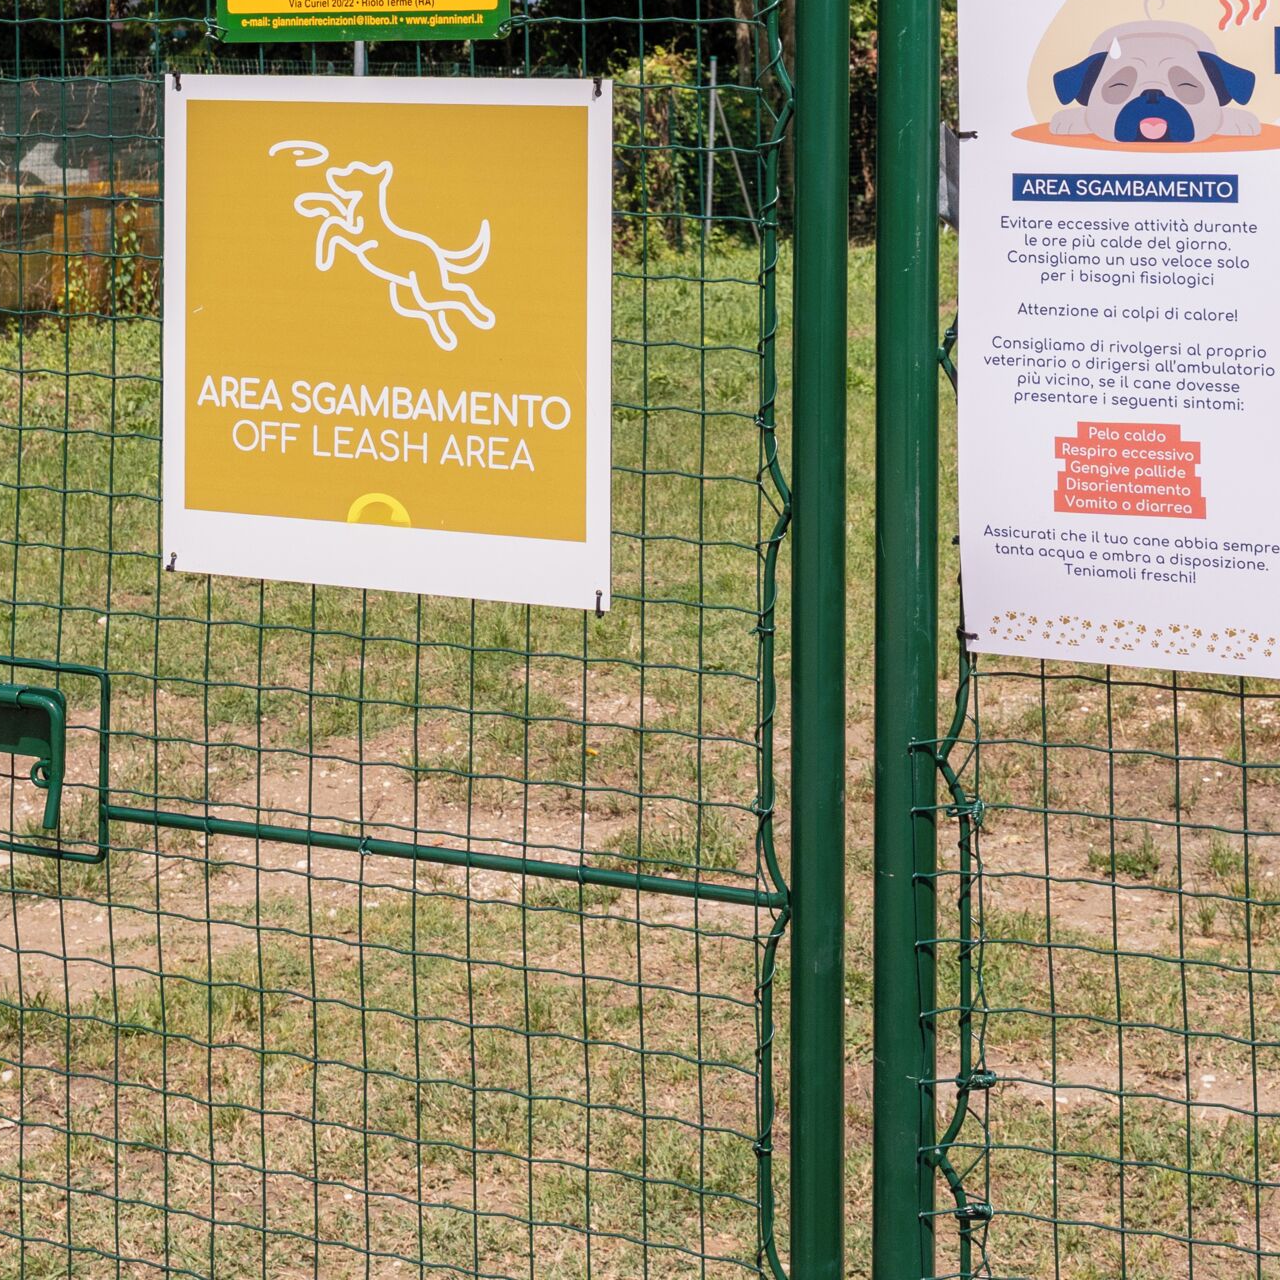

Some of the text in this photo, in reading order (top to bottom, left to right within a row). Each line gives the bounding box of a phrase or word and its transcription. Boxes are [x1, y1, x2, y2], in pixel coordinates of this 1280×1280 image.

[288, 0, 302, 8] Via
[241, 13, 484, 30] e-mail: gianninerirecinzioni@libero.it www.giannineri.it
[1022, 179, 1233, 198] AREA SGAMBAMENTO
[1001, 215, 1258, 234] Evitare eccessive attività durante
[1024, 233, 1231, 253] le ore più calde del giorno.
[1007, 250, 1250, 269] Consigliamo un uso veloce solo
[1040, 272, 1066, 284] per
[1080, 270, 1135, 287] bisogni
[1140, 270, 1214, 289] fisiologici
[1017, 302, 1238, 322] Attenzione ai colpi di calore!
[992, 335, 1267, 361] Consigliamo di rivolgersi al proprio
[984, 354, 1067, 368] veterinario
[1085, 357, 1150, 374] dirigersi
[1017, 371, 1240, 393] più vicino, se il cane dovesse
[197, 375, 571, 430] AREA SGAMBAMENTO
[1014, 392, 1098, 404] presentare
[1111, 395, 1177, 410] seguenti
[1183, 396, 1244, 411] sintomi:
[1088, 426, 1166, 442] Pelo caldo
[232, 419, 535, 472] OFF LEASH AREA
[1062, 442, 1194, 462] Respiro eccessivo
[1070, 460, 1186, 479] Gengive pallide
[1066, 477, 1191, 496] Disorientamento
[1064, 494, 1118, 510] Vomito
[1136, 499, 1192, 514] diarrea
[984, 524, 1280, 556] Assicurati che il tuo cane abbia sempre
[995, 543, 1034, 556] tanta
[1038, 548, 1085, 561] acqua
[1102, 550, 1151, 564] ombra
[1170, 553, 1269, 571] disposizione.
[1064, 563, 1196, 584] Teniamoli freschi!
